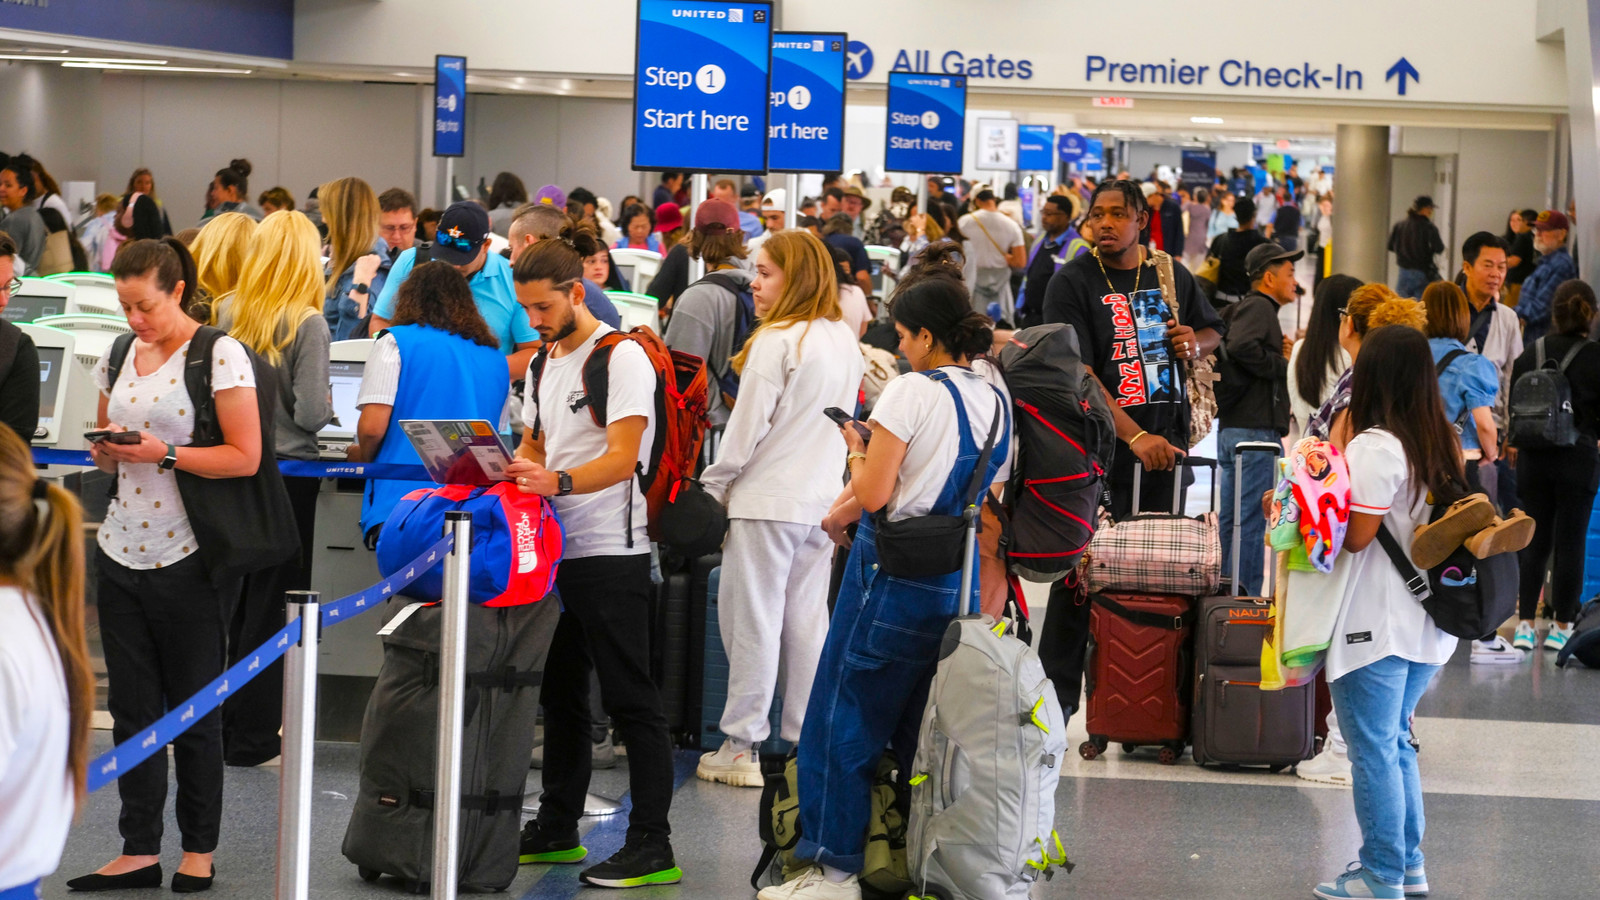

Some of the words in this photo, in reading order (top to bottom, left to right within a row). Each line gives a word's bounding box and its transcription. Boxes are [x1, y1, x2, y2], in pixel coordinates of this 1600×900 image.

[672, 9, 726, 19] UNITED
[892, 49, 930, 73] All
[941, 50, 1033, 80] Gates
[1085, 55, 1210, 85] Premier
[1219, 59, 1363, 90] Check-In
[645, 66, 693, 90] Step
[770, 91, 786, 107] ep
[643, 108, 695, 130] Start
[700, 110, 750, 131] here
[891, 112, 920, 126] Step
[768, 123, 788, 139] art
[791, 122, 829, 140] here
[890, 136, 921, 150] Start
[923, 137, 953, 151] here
[1102, 294, 1136, 339] HOOD
[1111, 342, 1126, 360] N
[1126, 338, 1138, 357] THE
[1116, 360, 1146, 407] BOYZ
[521, 512, 529, 551] NORTH
[1229, 609, 1270, 618] NAUT
